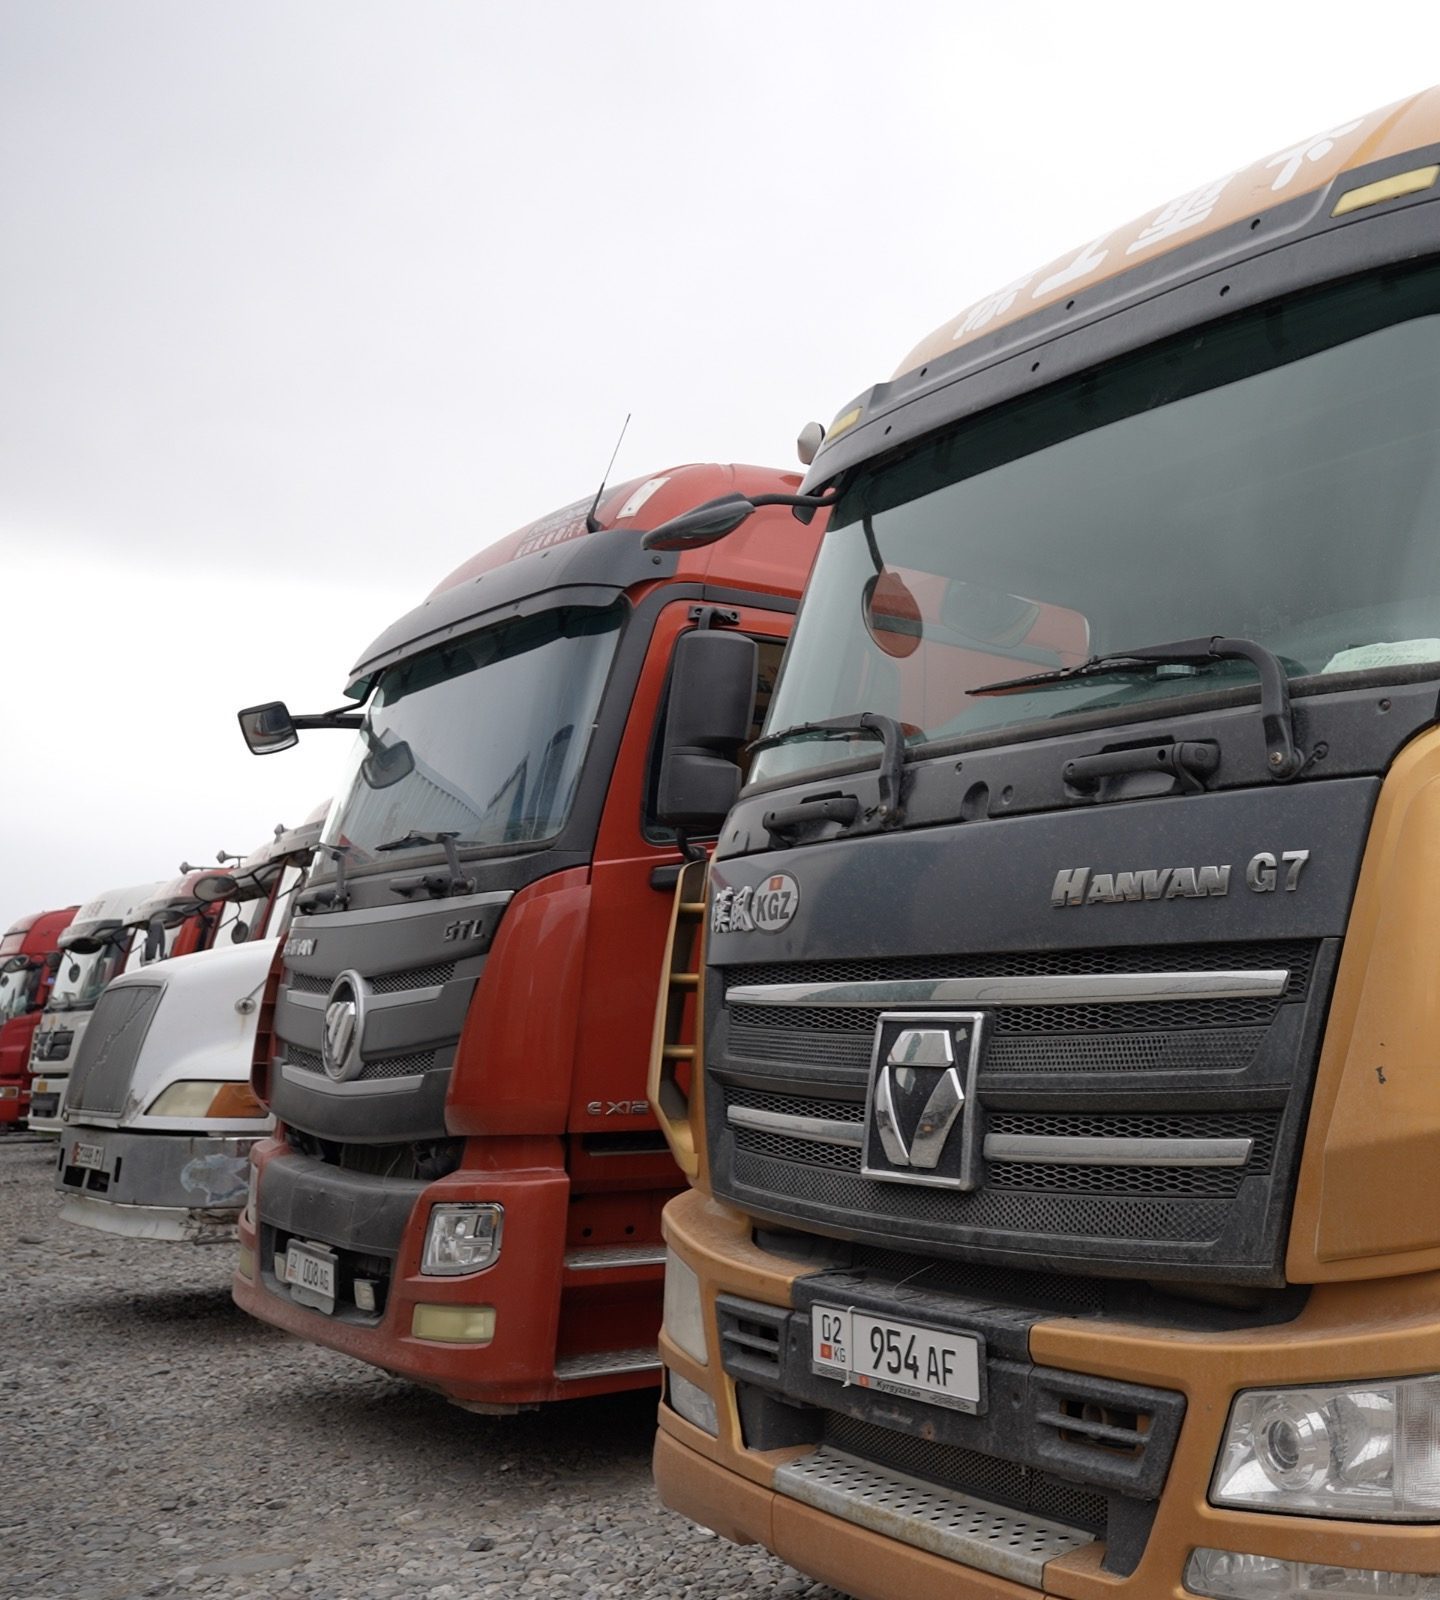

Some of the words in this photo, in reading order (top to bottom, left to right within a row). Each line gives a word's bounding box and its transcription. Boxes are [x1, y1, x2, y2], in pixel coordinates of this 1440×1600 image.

[1050, 866, 1232, 908] HANVAN
[1247, 850, 1310, 893] G7
[756, 891, 791, 922] KGZ
[833, 1347, 846, 1363] KG
[870, 1326, 920, 1380] 954
[927, 1346, 956, 1387] AF
[876, 1380, 921, 1398] Kyrgyzstan
